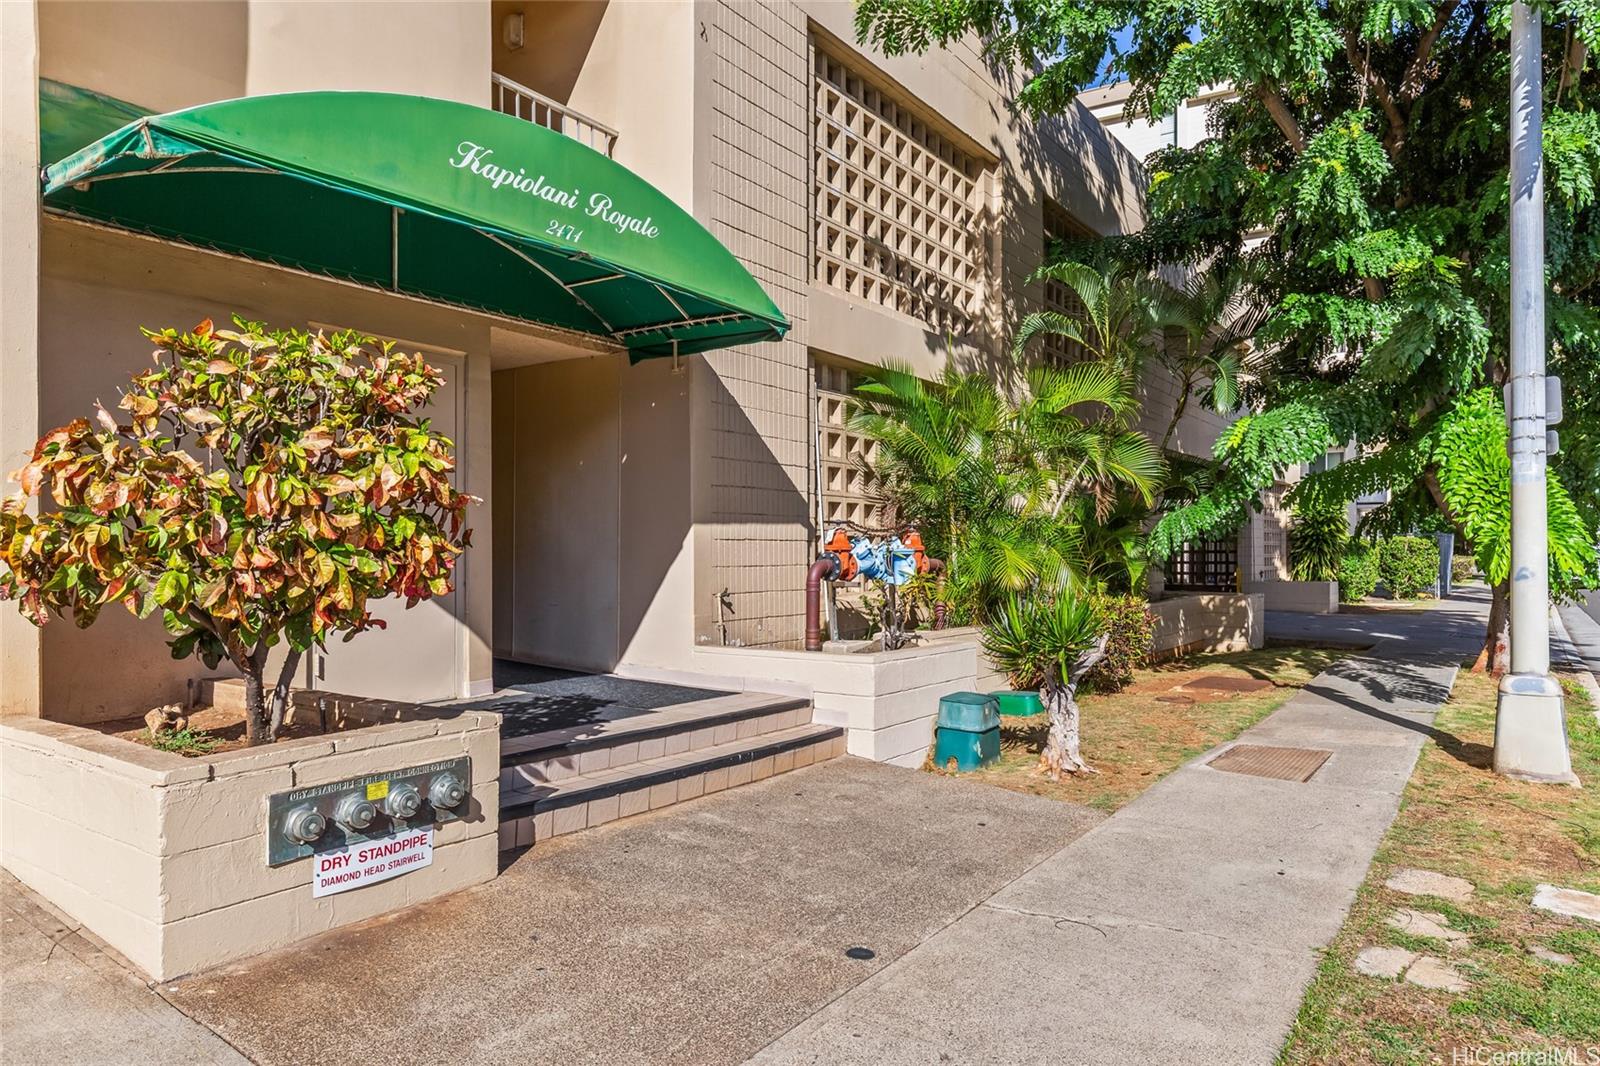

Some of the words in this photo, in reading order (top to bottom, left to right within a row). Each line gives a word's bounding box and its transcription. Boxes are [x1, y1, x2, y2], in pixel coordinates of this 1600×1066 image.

[449, 141, 578, 209] Kapiolani
[584, 193, 660, 239] Royale
[321, 854, 352, 872] DRY
[358, 833, 428, 863] STANDPIPE
[321, 870, 361, 888] DIAMOND
[364, 864, 386, 877] HEAD
[387, 852, 426, 870] STAIRWELL
